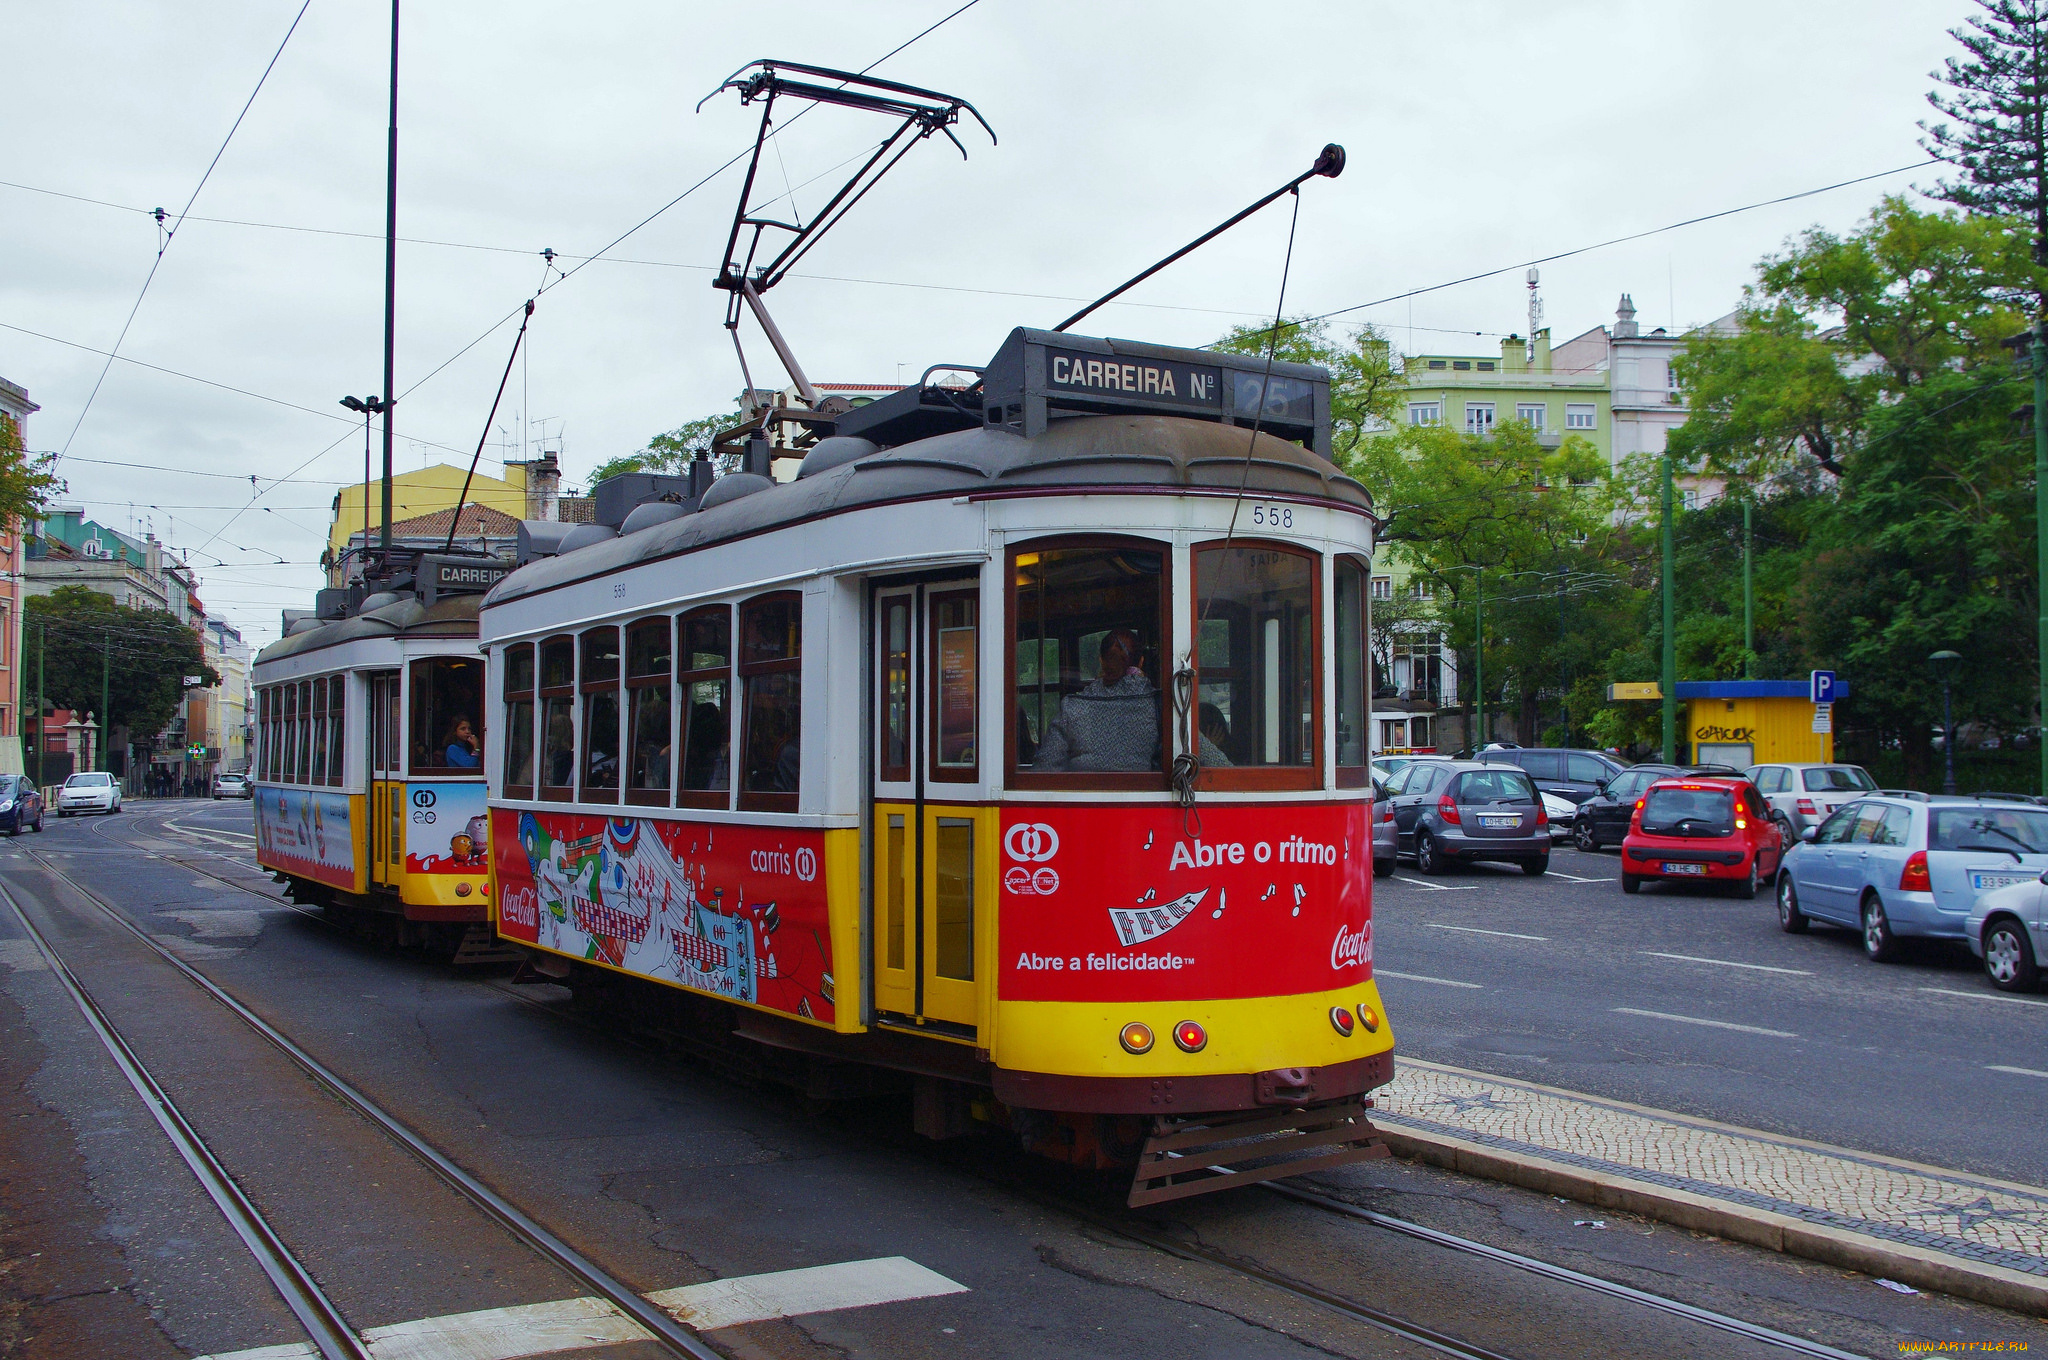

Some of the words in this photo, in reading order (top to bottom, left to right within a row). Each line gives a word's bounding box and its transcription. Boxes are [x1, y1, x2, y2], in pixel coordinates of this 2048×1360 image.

[1053, 356, 1176, 396] CARREIRA
[1243, 379, 1290, 416] 25
[1254, 506, 1292, 528] 558
[1818, 676, 1830, 698] P
[750, 843, 791, 875] carris
[1169, 839, 1245, 871] Abre
[1254, 841, 1271, 863] o
[1280, 834, 1337, 866] ritmo
[1016, 953, 1064, 970] Abre
[1069, 957, 1081, 970] a
